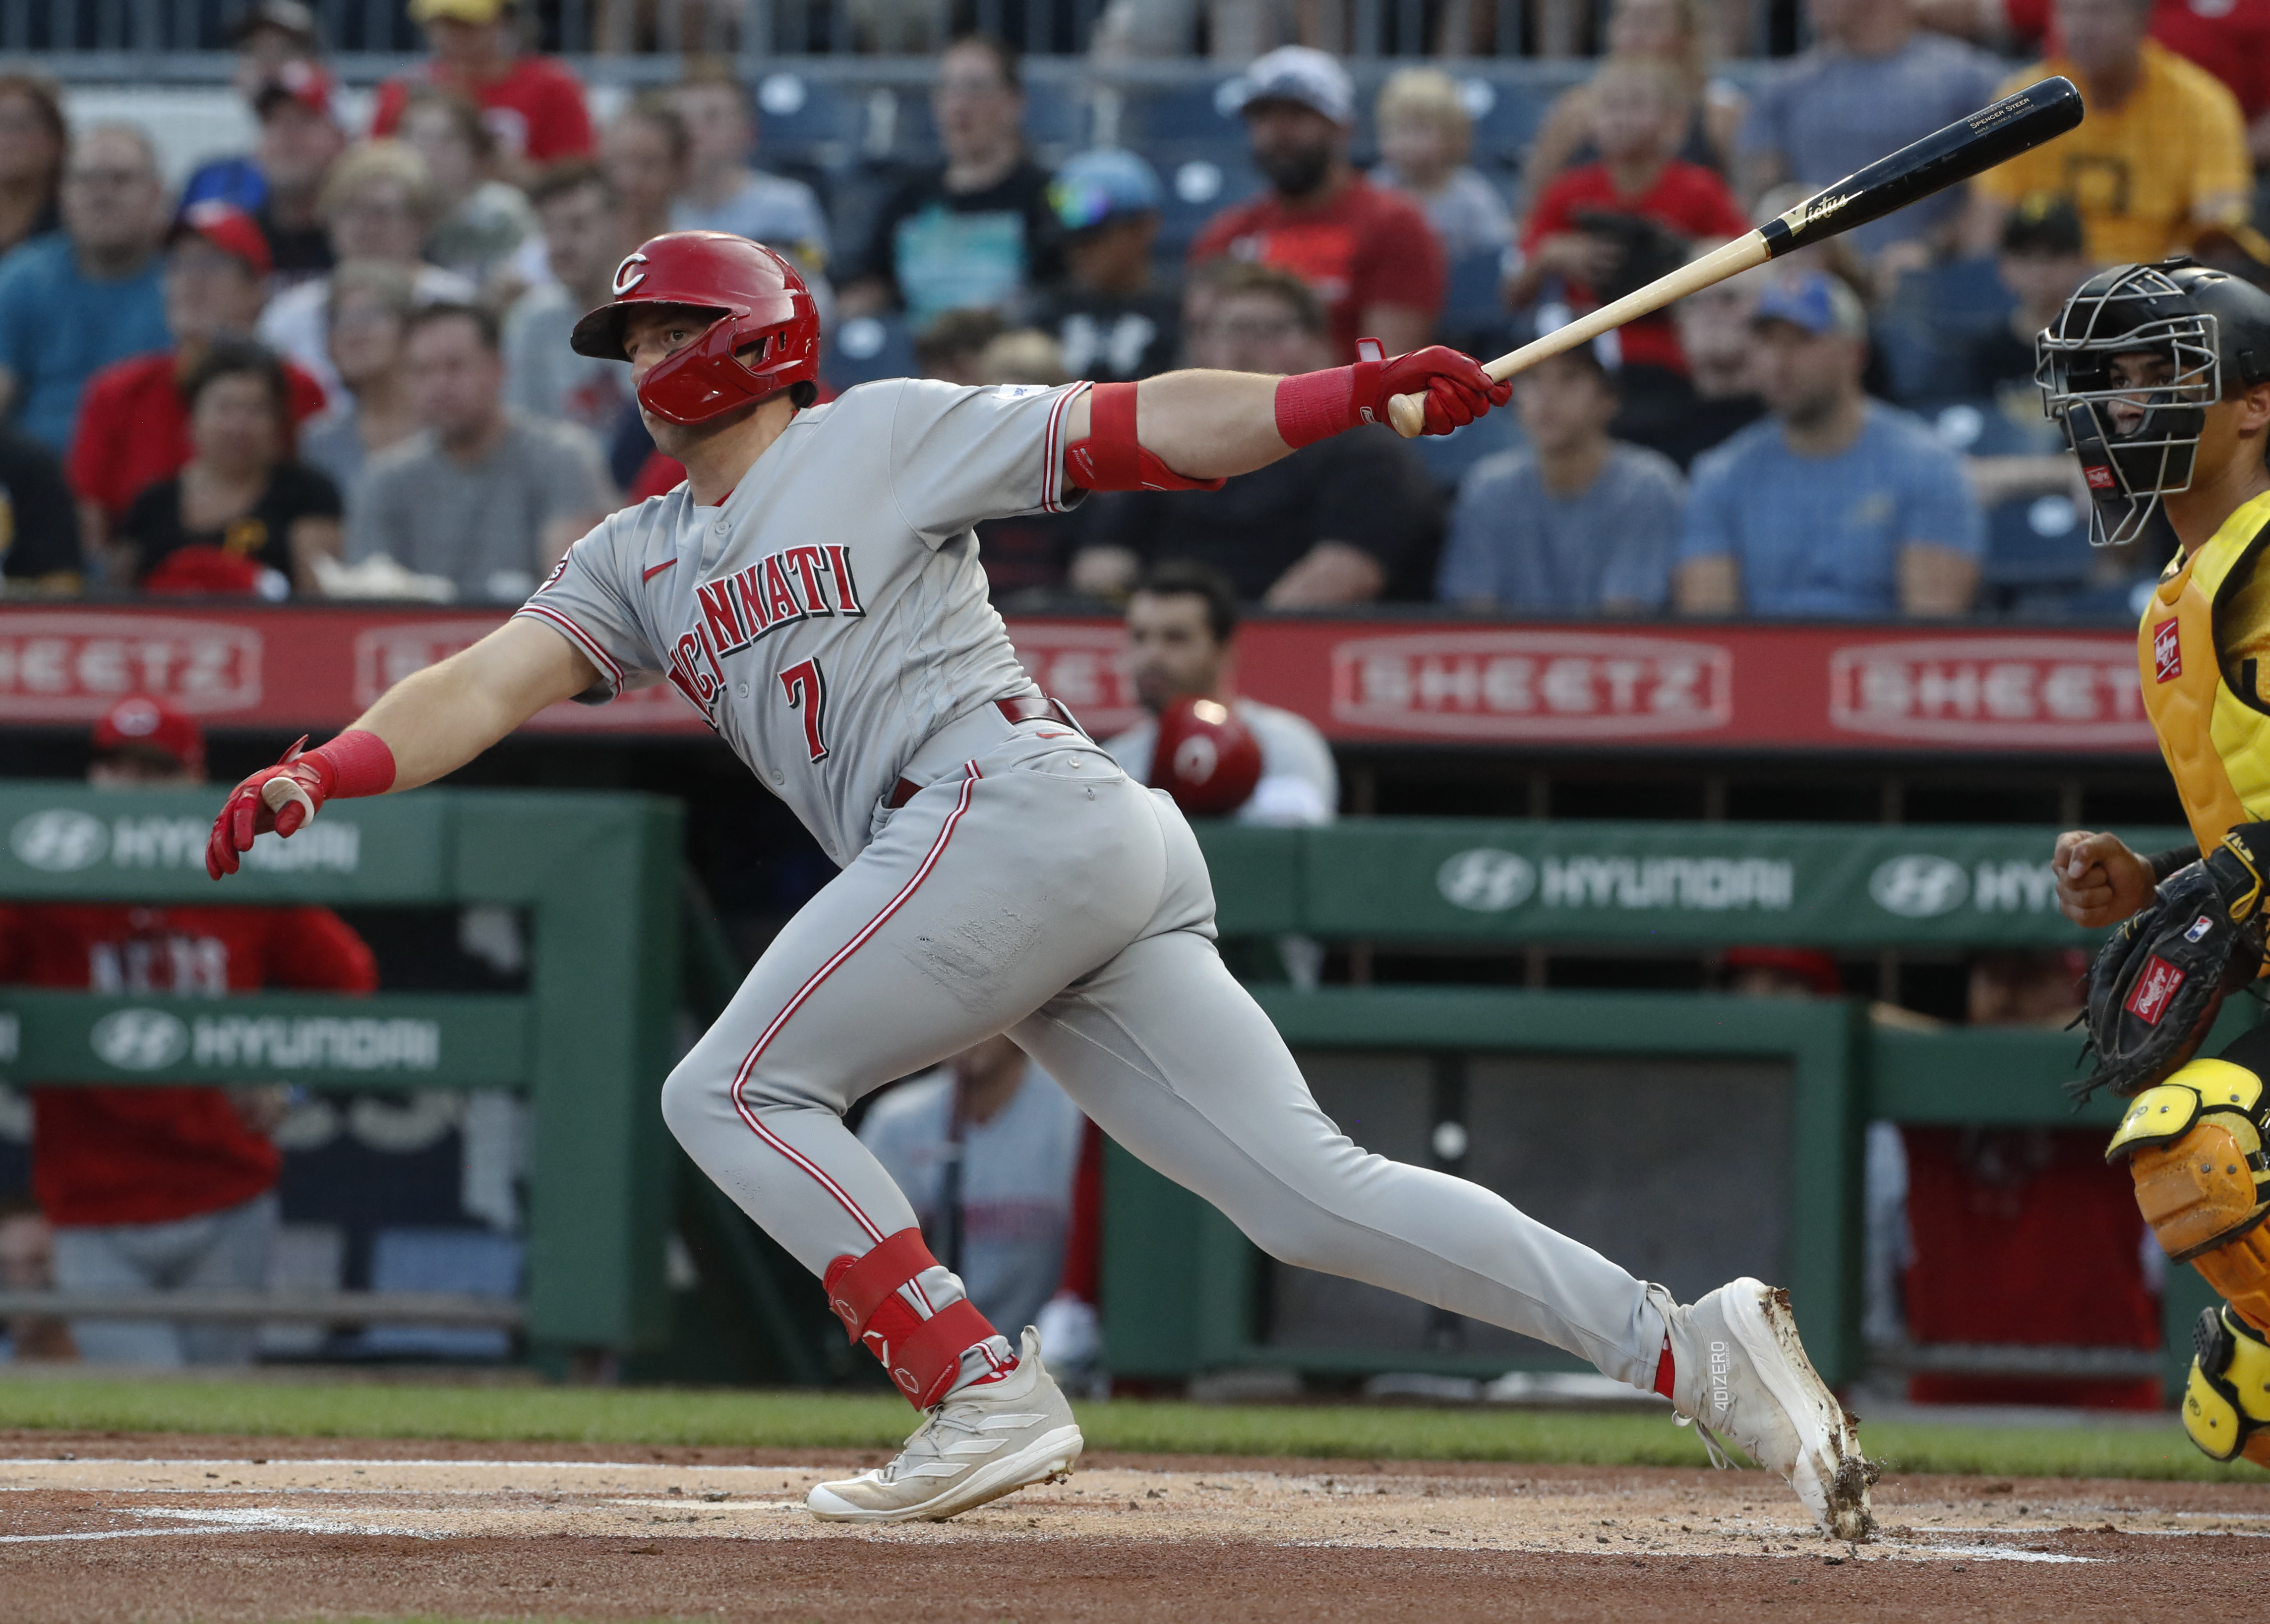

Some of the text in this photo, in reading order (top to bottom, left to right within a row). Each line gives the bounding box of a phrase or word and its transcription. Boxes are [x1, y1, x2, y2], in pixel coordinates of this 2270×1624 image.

[1970, 110, 2005, 129] SPENCER
[2005, 98, 2030, 112] STEER
[1778, 194, 1848, 237] Victus
[612, 253, 647, 296] C
[777, 656, 829, 764] 7
[1362, 655, 1698, 712] SHEETZ
[1863, 662, 2141, 718] SHEET
[1540, 856, 1793, 909] HYUNDAI
[192, 1014, 440, 1070] HYUNDAI
